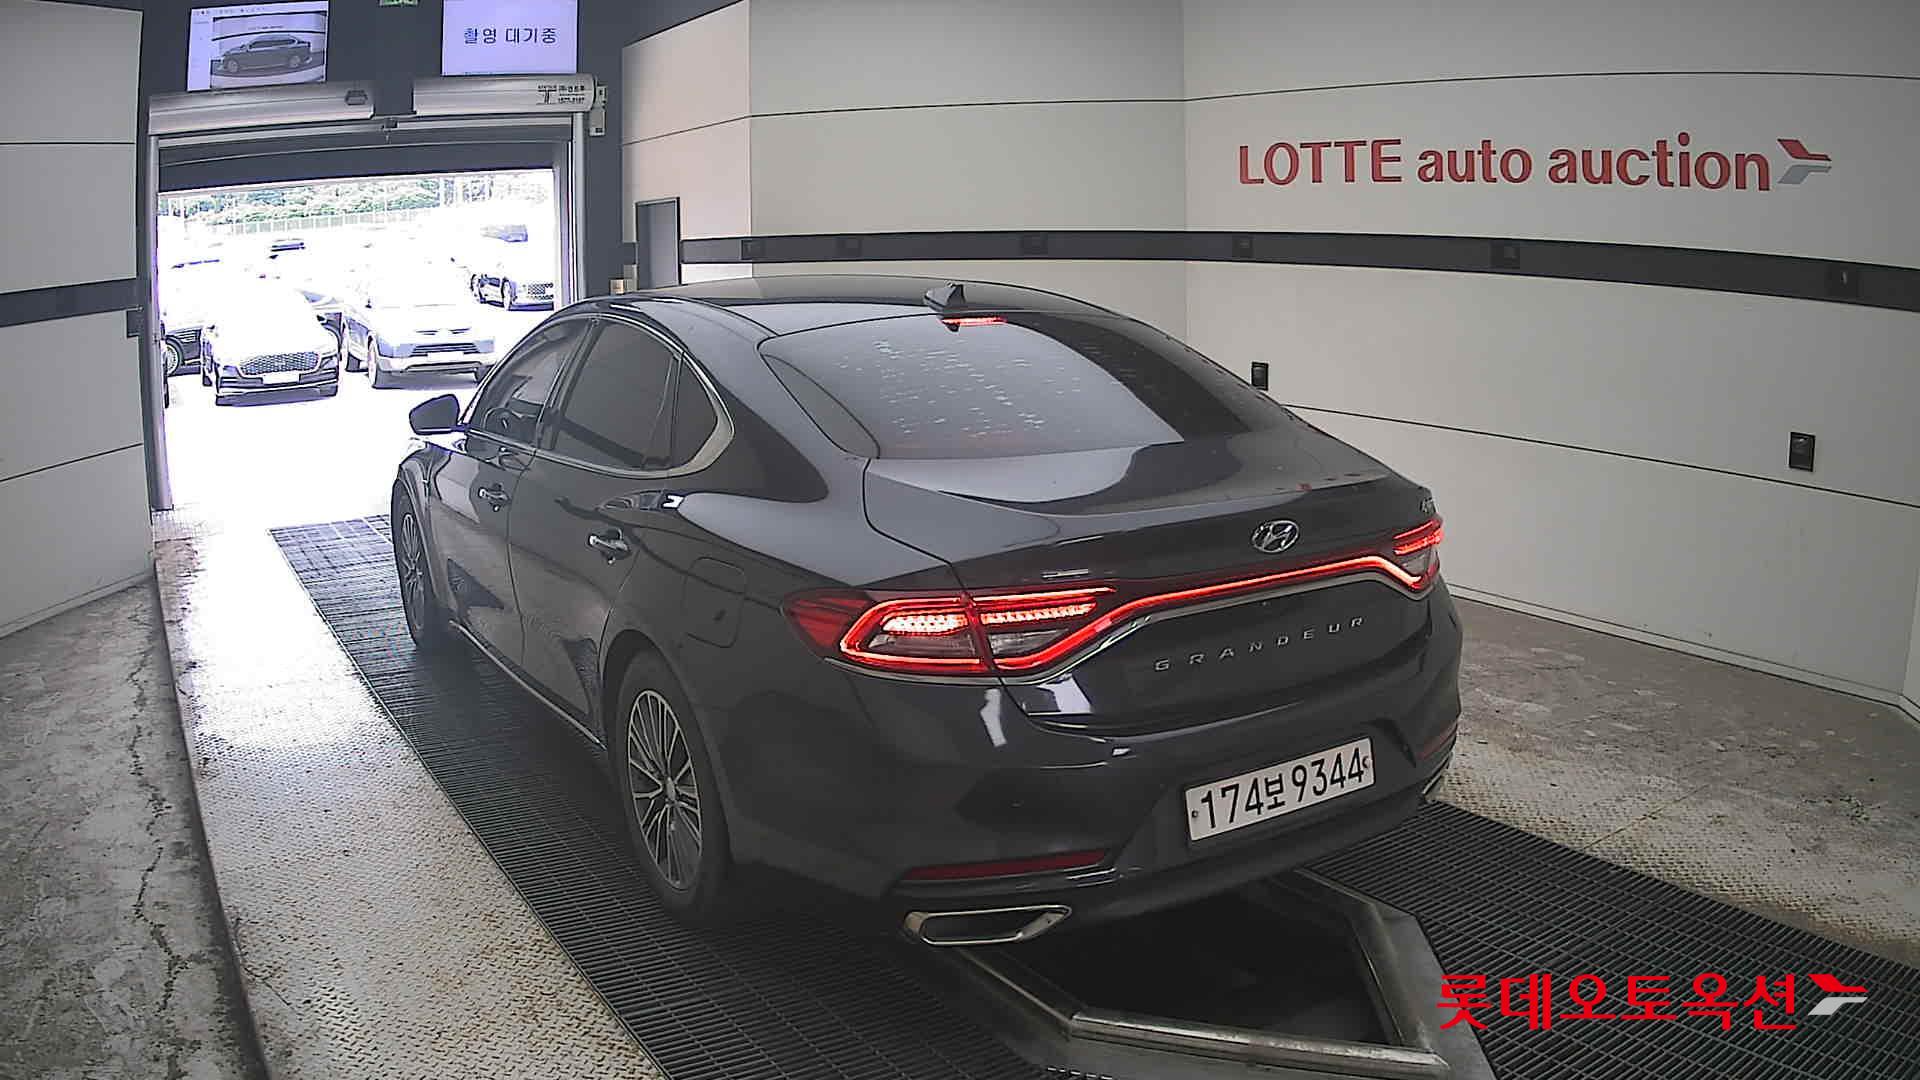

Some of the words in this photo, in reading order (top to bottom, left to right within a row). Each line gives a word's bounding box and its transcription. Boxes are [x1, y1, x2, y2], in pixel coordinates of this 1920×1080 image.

[464, 28, 497, 44] 촬영
[505, 27, 557, 44] 대기중
[1239, 138, 1402, 185] LOTTE
[1416, 139, 1533, 183] auto
[1549, 131, 1771, 191] auction
[1154, 616, 1363, 671] GRANDEUR
